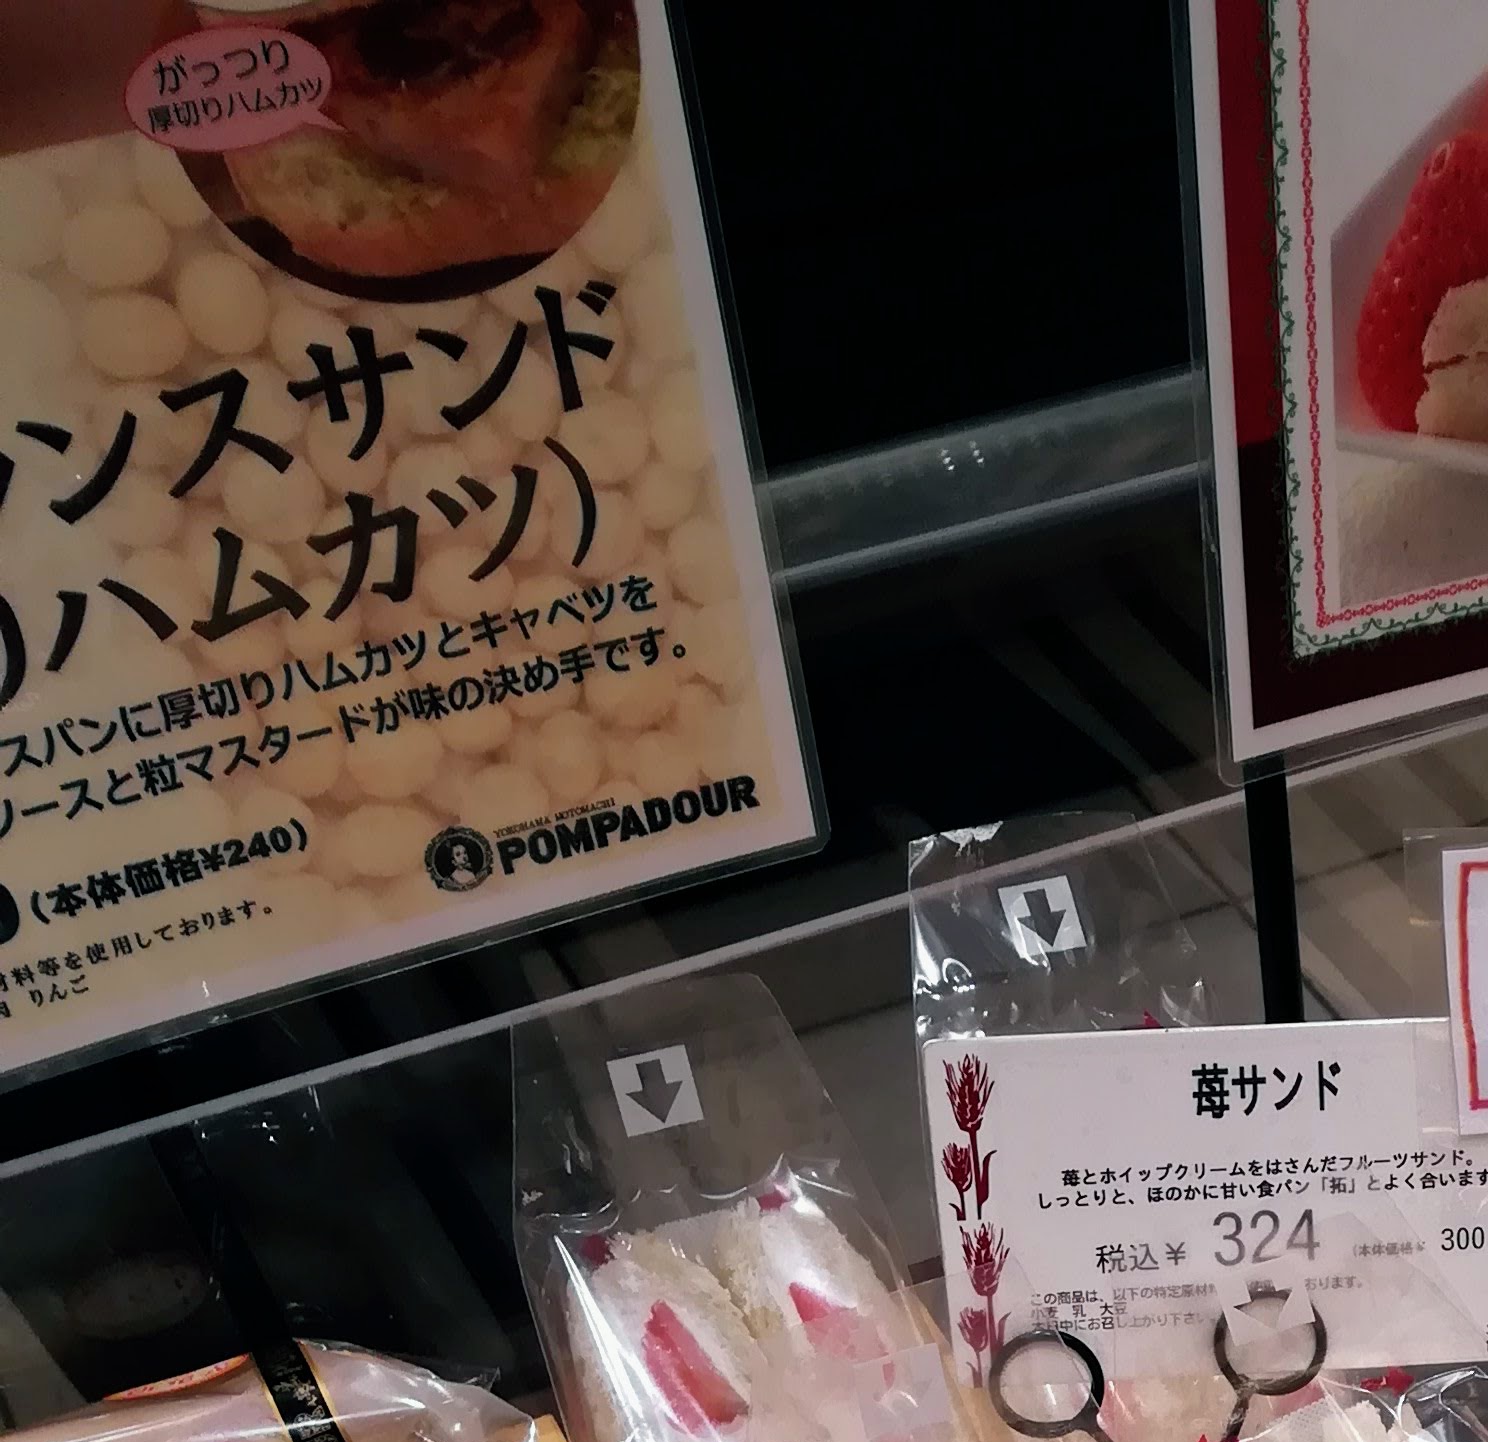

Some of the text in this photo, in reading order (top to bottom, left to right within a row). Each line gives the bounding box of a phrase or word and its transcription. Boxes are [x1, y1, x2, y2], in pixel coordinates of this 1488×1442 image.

[153, 39, 289, 96] がっつり
[148, 76, 322, 134] 厚切りハムカツ
[0, 280, 617, 525] ンスサンド
[496, 774, 761, 876] POMPADOUR
[1191, 1060, 1341, 1119] 苺サンド
[1061, 1149, 1475, 1187] 苺とホイップクリームをはさんだフルーツサンド。
[1212, 1208, 1320, 1267] 324
[1440, 1226, 1486, 1252] 300
